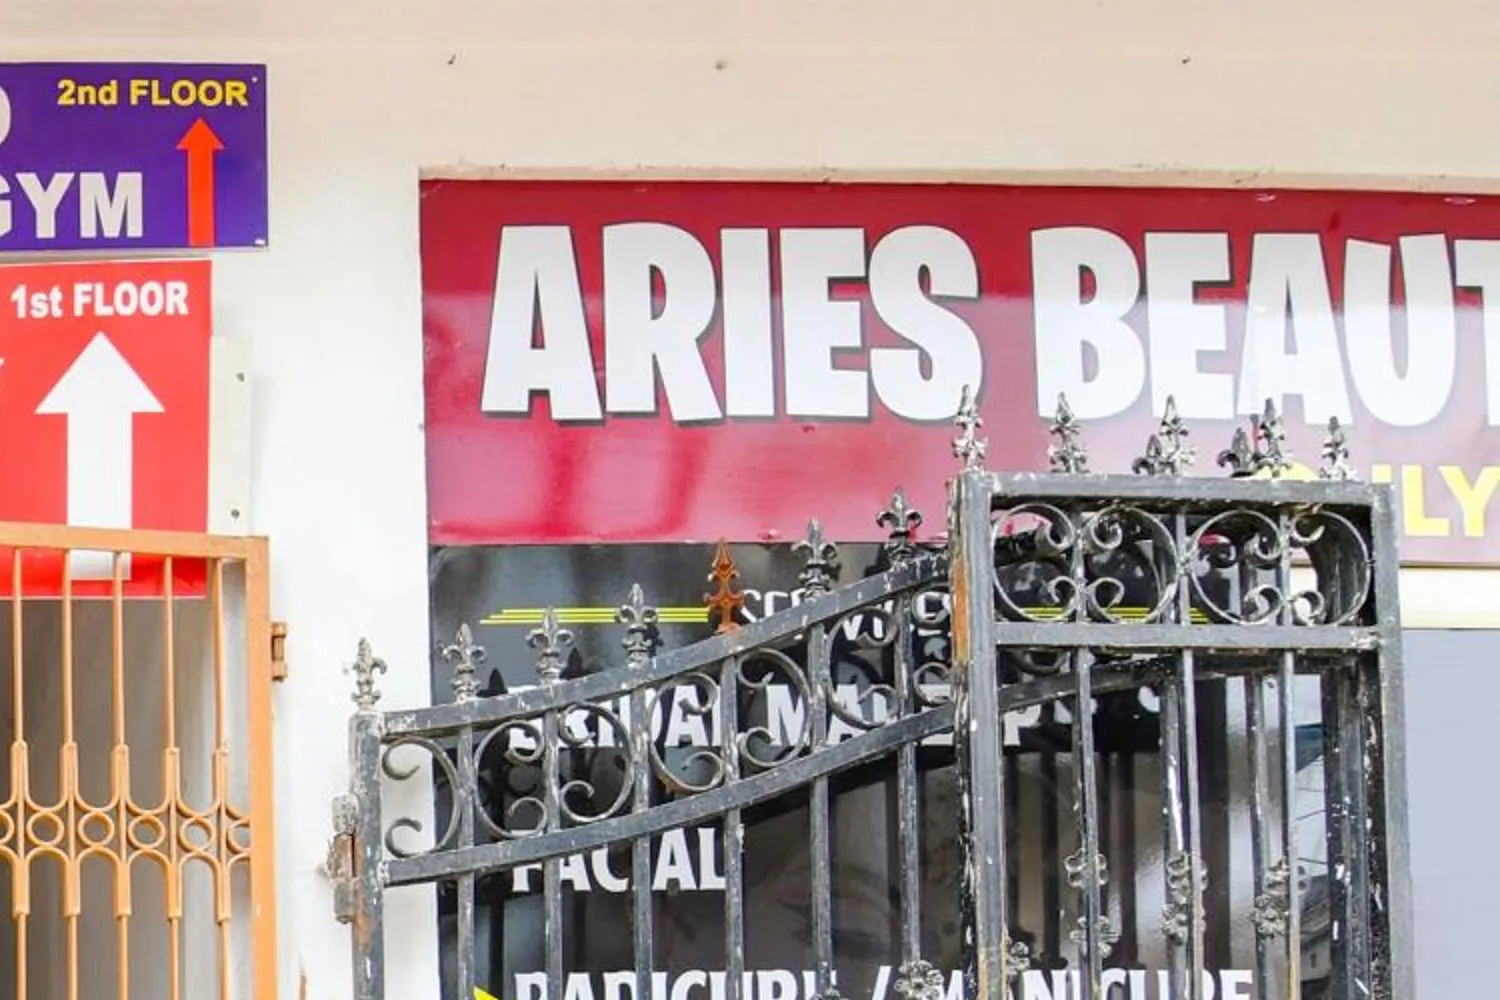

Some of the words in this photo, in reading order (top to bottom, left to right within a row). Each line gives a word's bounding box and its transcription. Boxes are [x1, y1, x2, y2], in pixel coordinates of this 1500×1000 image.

[57, 79, 117, 107] 2nd
[130, 78, 248, 107] FLOOR
[11, 285, 64, 320] 1st
[73, 281, 189, 317] FLOOR
[481, 223, 982, 421] ARIES
[511, 828, 728, 891] FACAL
